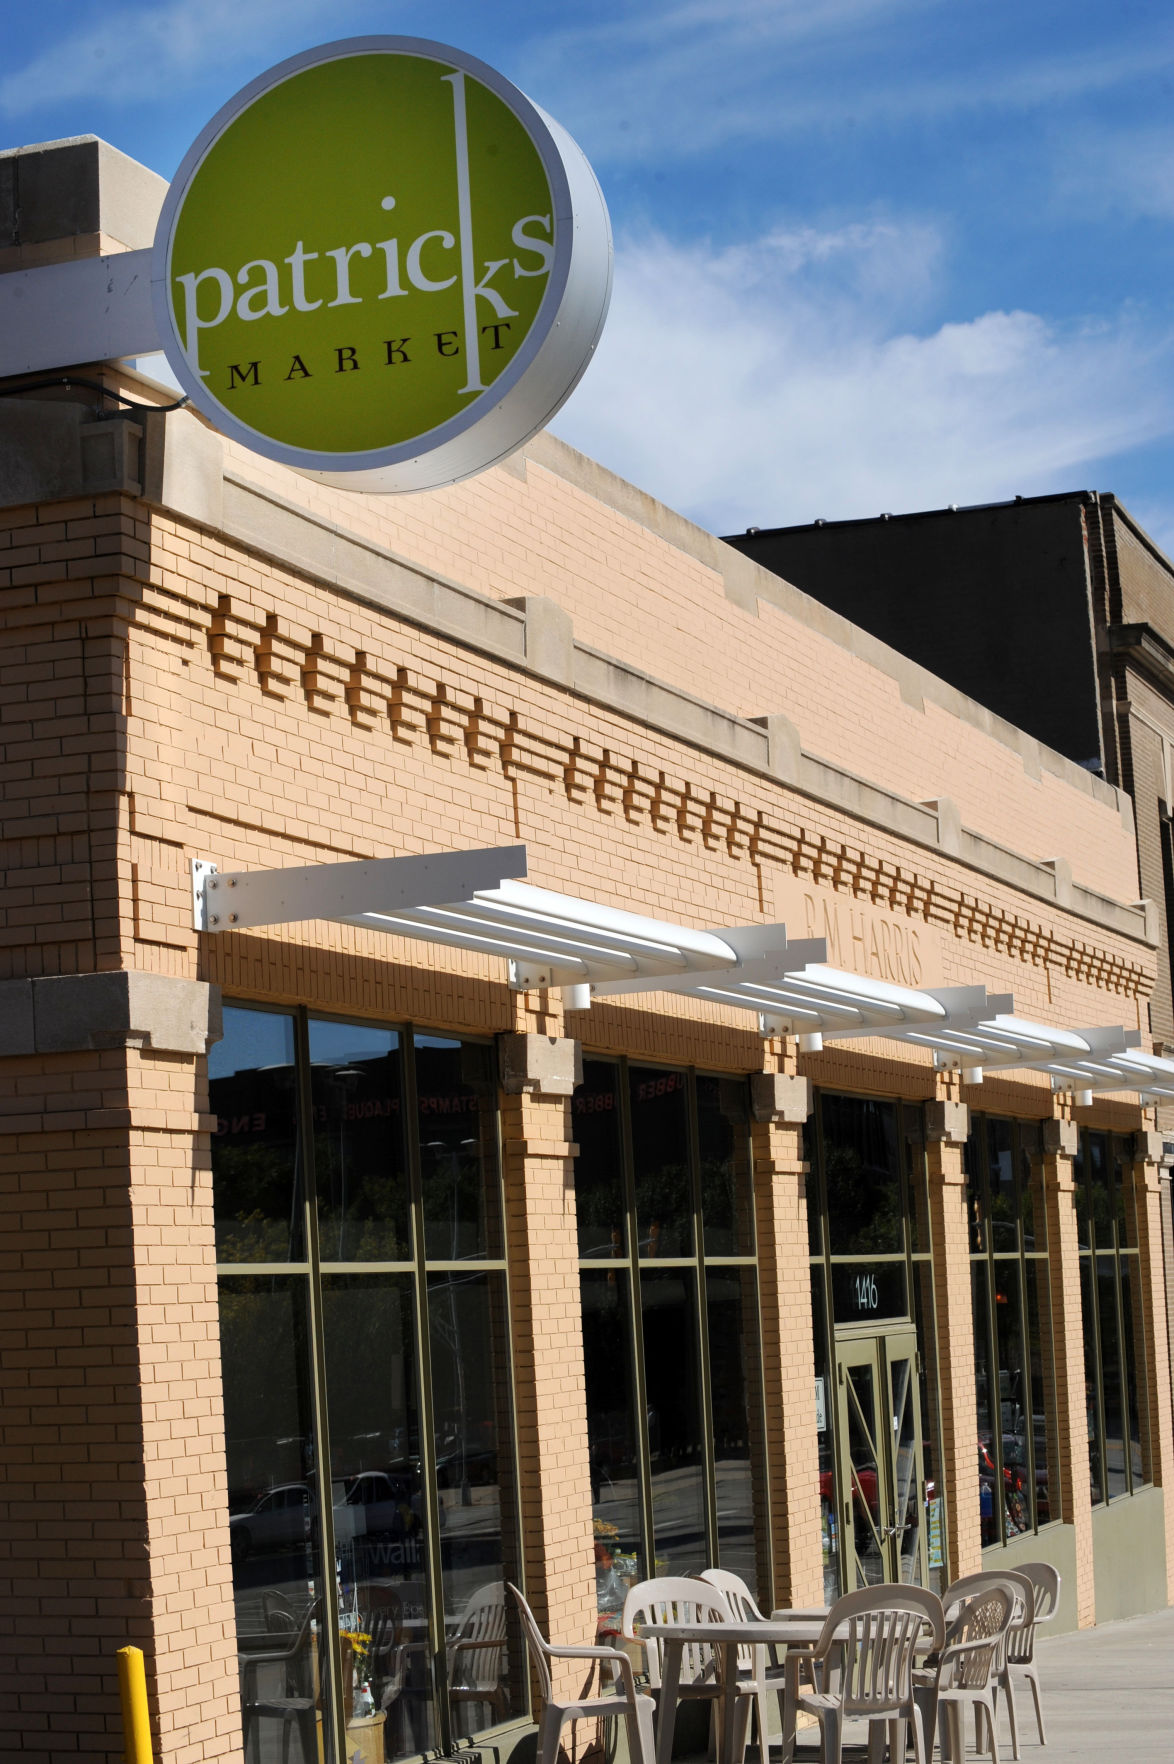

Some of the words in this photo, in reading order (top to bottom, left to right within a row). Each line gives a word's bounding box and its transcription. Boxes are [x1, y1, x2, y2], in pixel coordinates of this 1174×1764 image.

[175, 71, 555, 394] patricks
[227, 323, 512, 390] MARKET
[849, 908, 923, 986] HARRIS
[855, 1273, 878, 1310] 1416
